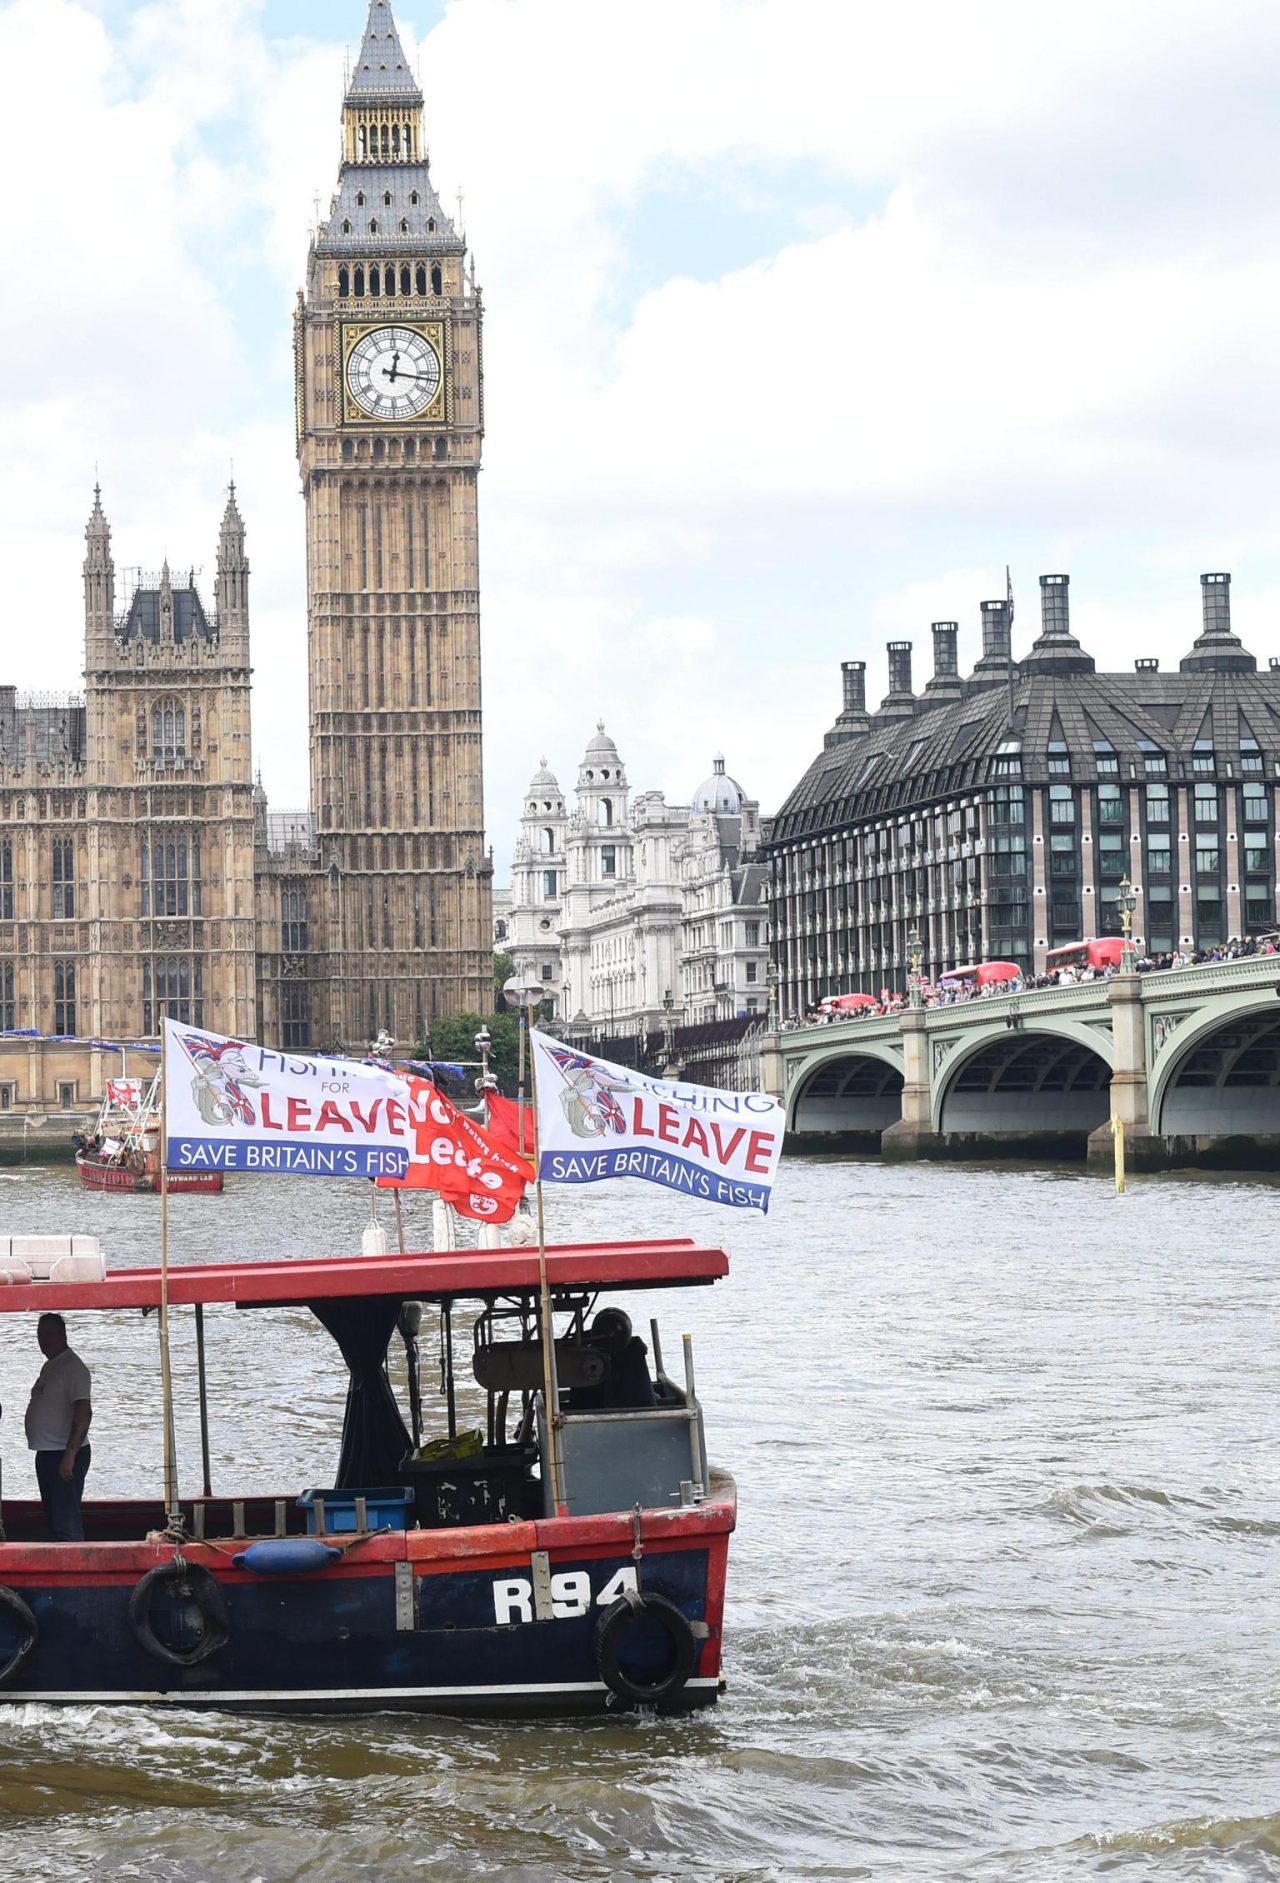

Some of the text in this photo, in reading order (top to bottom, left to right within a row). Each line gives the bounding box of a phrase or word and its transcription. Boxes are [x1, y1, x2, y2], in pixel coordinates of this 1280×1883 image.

[321, 1082, 350, 1094] FOR
[261, 1092, 406, 1136] LEAVE
[633, 1096, 775, 1174] LEAVE
[179, 1143, 409, 1174] SAVE BRITAIN'S FISH
[552, 1151, 766, 1208] SAVE BRITAIN'S FISH
[493, 1567, 638, 1625] R94
